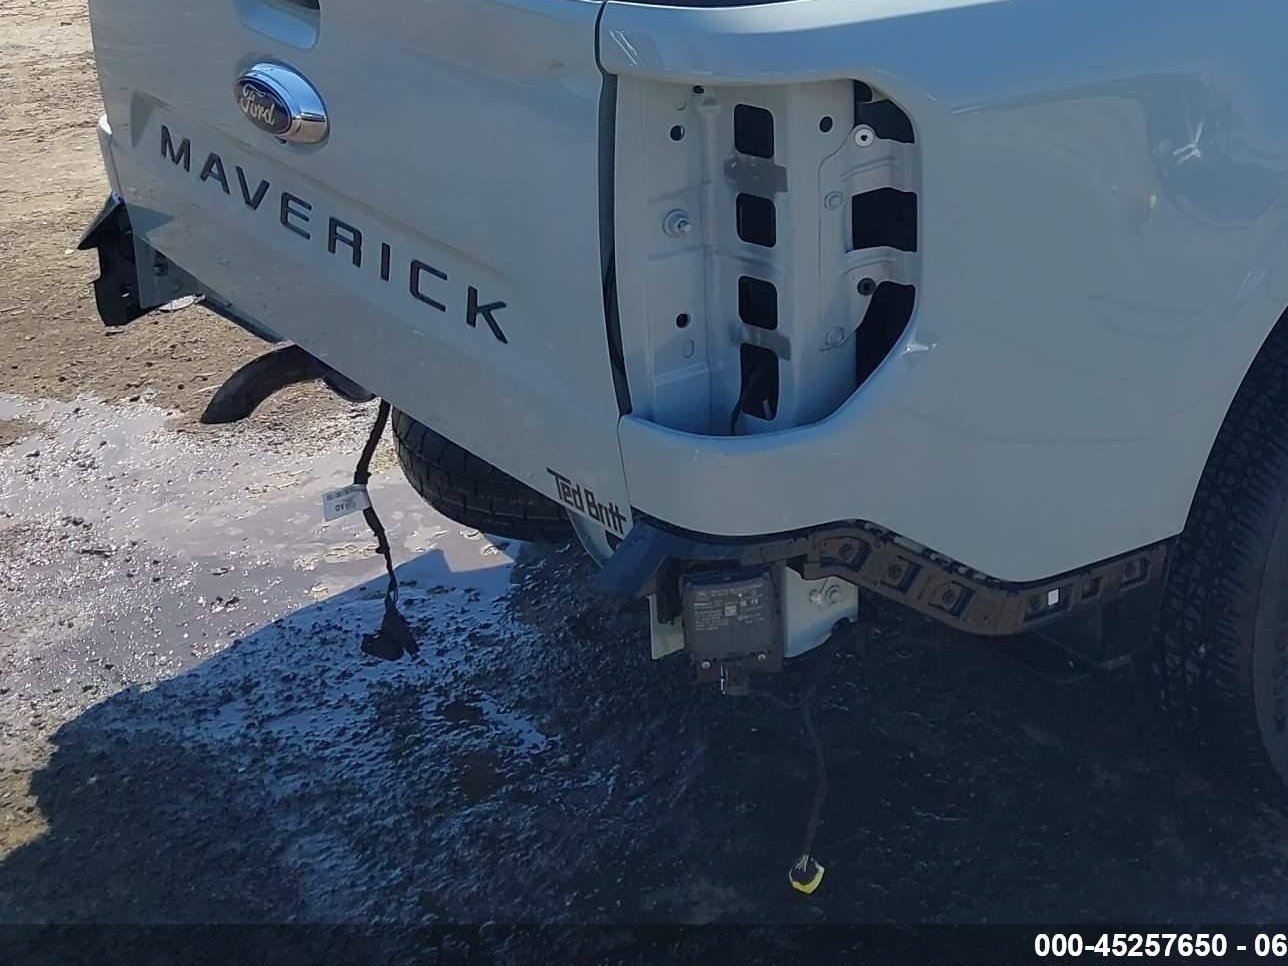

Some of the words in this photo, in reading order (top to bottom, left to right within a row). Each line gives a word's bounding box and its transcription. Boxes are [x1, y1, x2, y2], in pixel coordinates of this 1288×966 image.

[240, 83, 276, 126] Ford
[159, 124, 509, 345] MAVERICK
[546, 466, 585, 514] Ted
[584, 487, 628, 536] Britt
